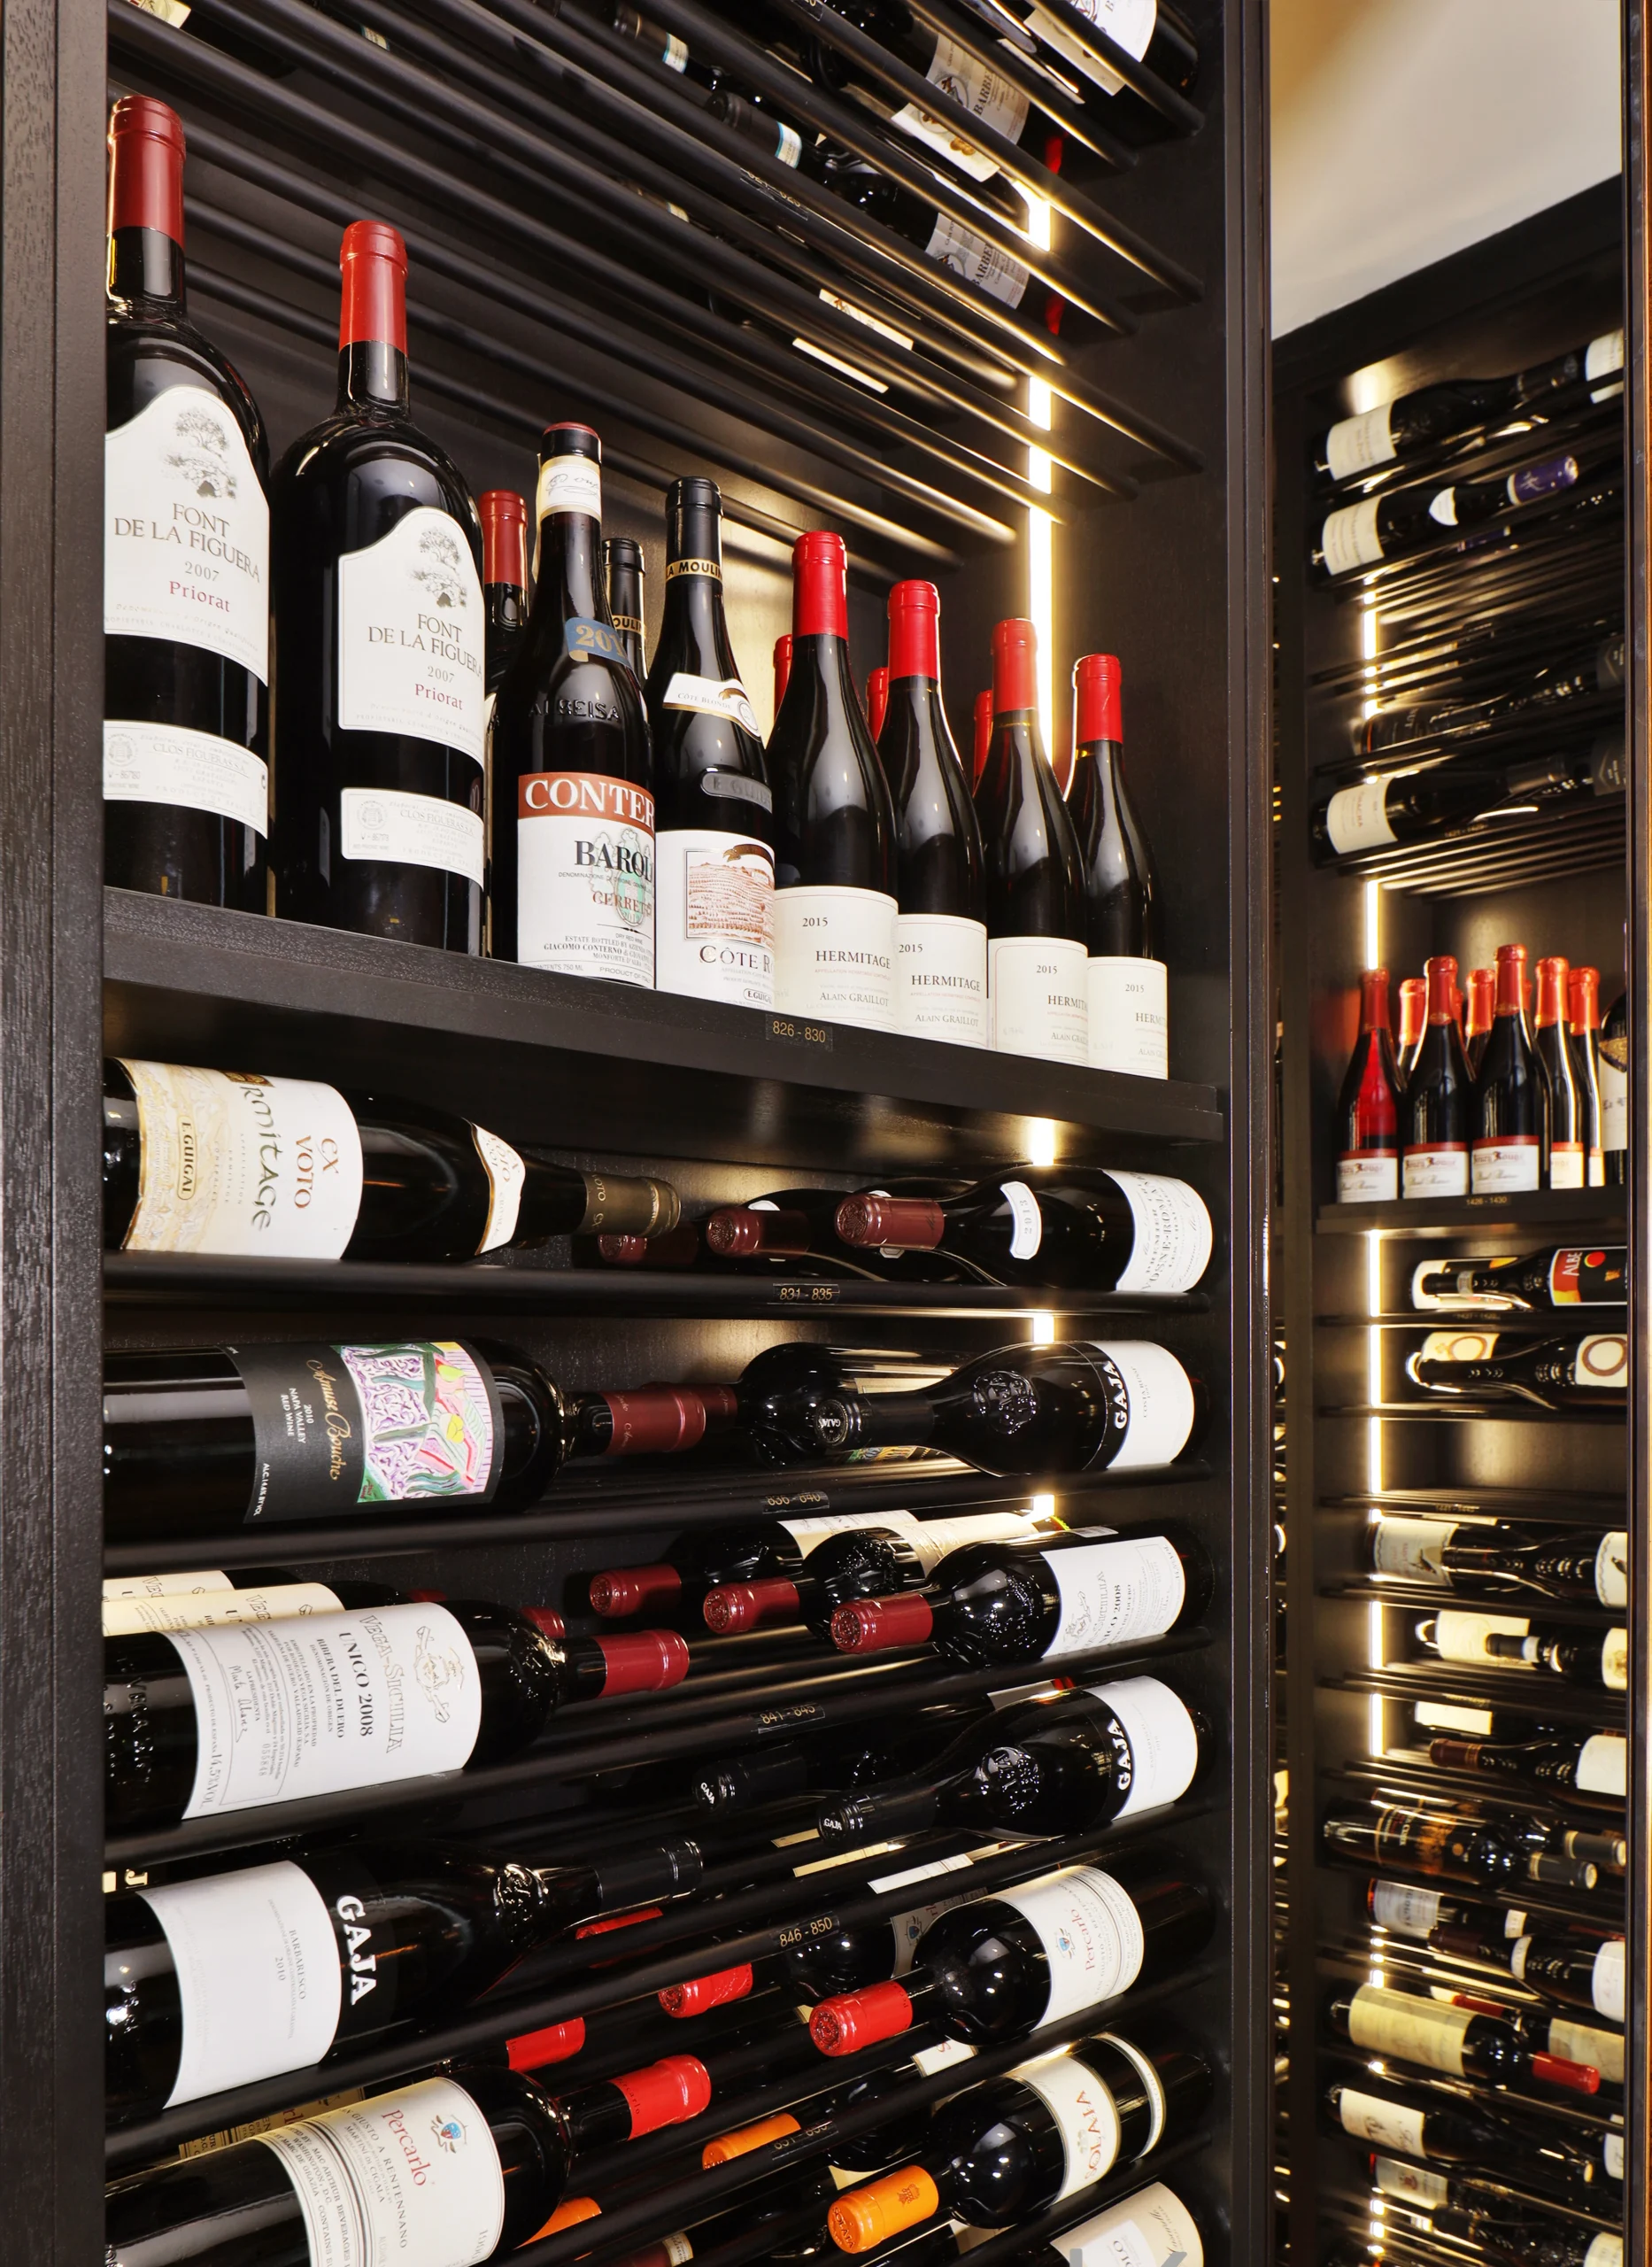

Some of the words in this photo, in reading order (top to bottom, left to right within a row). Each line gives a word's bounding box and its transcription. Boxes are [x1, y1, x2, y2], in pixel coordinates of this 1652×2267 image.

[173, 502, 230, 538] FONT
[114, 517, 145, 538] DE
[151, 521, 182, 545] LA
[189, 530, 260, 584] FIGUERA
[184, 561, 220, 582] 2007
[169, 581, 230, 613] Priorat
[368, 626, 395, 644] DE
[400, 630, 427, 651] LA
[418, 613, 463, 643] FONT
[427, 665, 455, 684] 2007
[415, 683, 463, 710] Priorat
[152, 742, 183, 755] CLOS
[186, 747, 235, 769] FIGUERAS
[400, 810, 426, 821] CLOS
[427, 813, 466, 832] FIGUERAS
[802, 917, 829, 927] 2015
[583, 944, 623, 954] CONTERNO
[591, 937, 620, 947] BOTTLED
[899, 944, 923, 953] 2015
[600, 967, 633, 977] PRODUCT
[815, 950, 892, 970] HERMITAGE
[1036, 965, 1058, 975] 2015
[911, 975, 981, 992] HERMITAGE
[1125, 983, 1145, 993] 2015
[820, 992, 847, 1001] ALAIN
[849, 993, 890, 1007] GRAILLOT
[773, 1020, 795, 1037] 826
[805, 1027, 826, 1043] 830
[915, 1014, 940, 1022] ALAIN
[942, 1015, 980, 1027] GRAILLOT
[1051, 1032, 1071, 1041] ALAIN
[294, 1135, 314, 1209] VOTO
[1019, 1199, 1033, 1235] 2013
[780, 1288, 800, 1300] 831
[811, 1288, 833, 1300] 835
[281, 1394, 291, 1415] RED
[289, 1387, 302, 1411] NAPA
[1103, 1361, 1128, 1429] GAJA
[285, 1412, 295, 1437] WINE
[295, 1411, 306, 1444] VALLEY
[303, 1404, 314, 1424] 2010
[325, 1412, 352, 1481] Bouche
[1113, 1584, 1122, 1613] 2008
[316, 1638, 336, 1672] RIBERA
[331, 1673, 342, 1694] DEL
[338, 1632, 371, 1688] UNICO
[358, 1693, 374, 1737] 2008
[359, 1614, 405, 1754] VEGA-SICILIA
[335, 1698, 345, 1738] DUERO
[1109, 1719, 1131, 1790] GAJA
[823, 1818, 843, 1831] GAJA
[779, 1928, 803, 1948] 846
[811, 1916, 833, 1935] 850
[1071, 1909, 1095, 1971] Percarlo
[336, 1895, 378, 2006] GAJA
[275, 1956, 286, 1982] 2010
[289, 1929, 307, 2000] BARBARESCO
[381, 2109, 432, 2186] Percarlo
[351, 2112, 381, 2142] GIUSTO
[377, 2145, 386, 2154] A
[383, 2158, 408, 2249] RENTENNANO
[369, 2166, 386, 2204] CIGALA
[282, 2137, 298, 2157] MARC
[302, 2165, 320, 2197] GRAZIA
[317, 2205, 333, 2255] CONTAINS
[313, 2147, 325, 2166] MAC
[321, 2165, 340, 2202] ARTHUR
[336, 2204, 351, 2261] BEVERAGES
